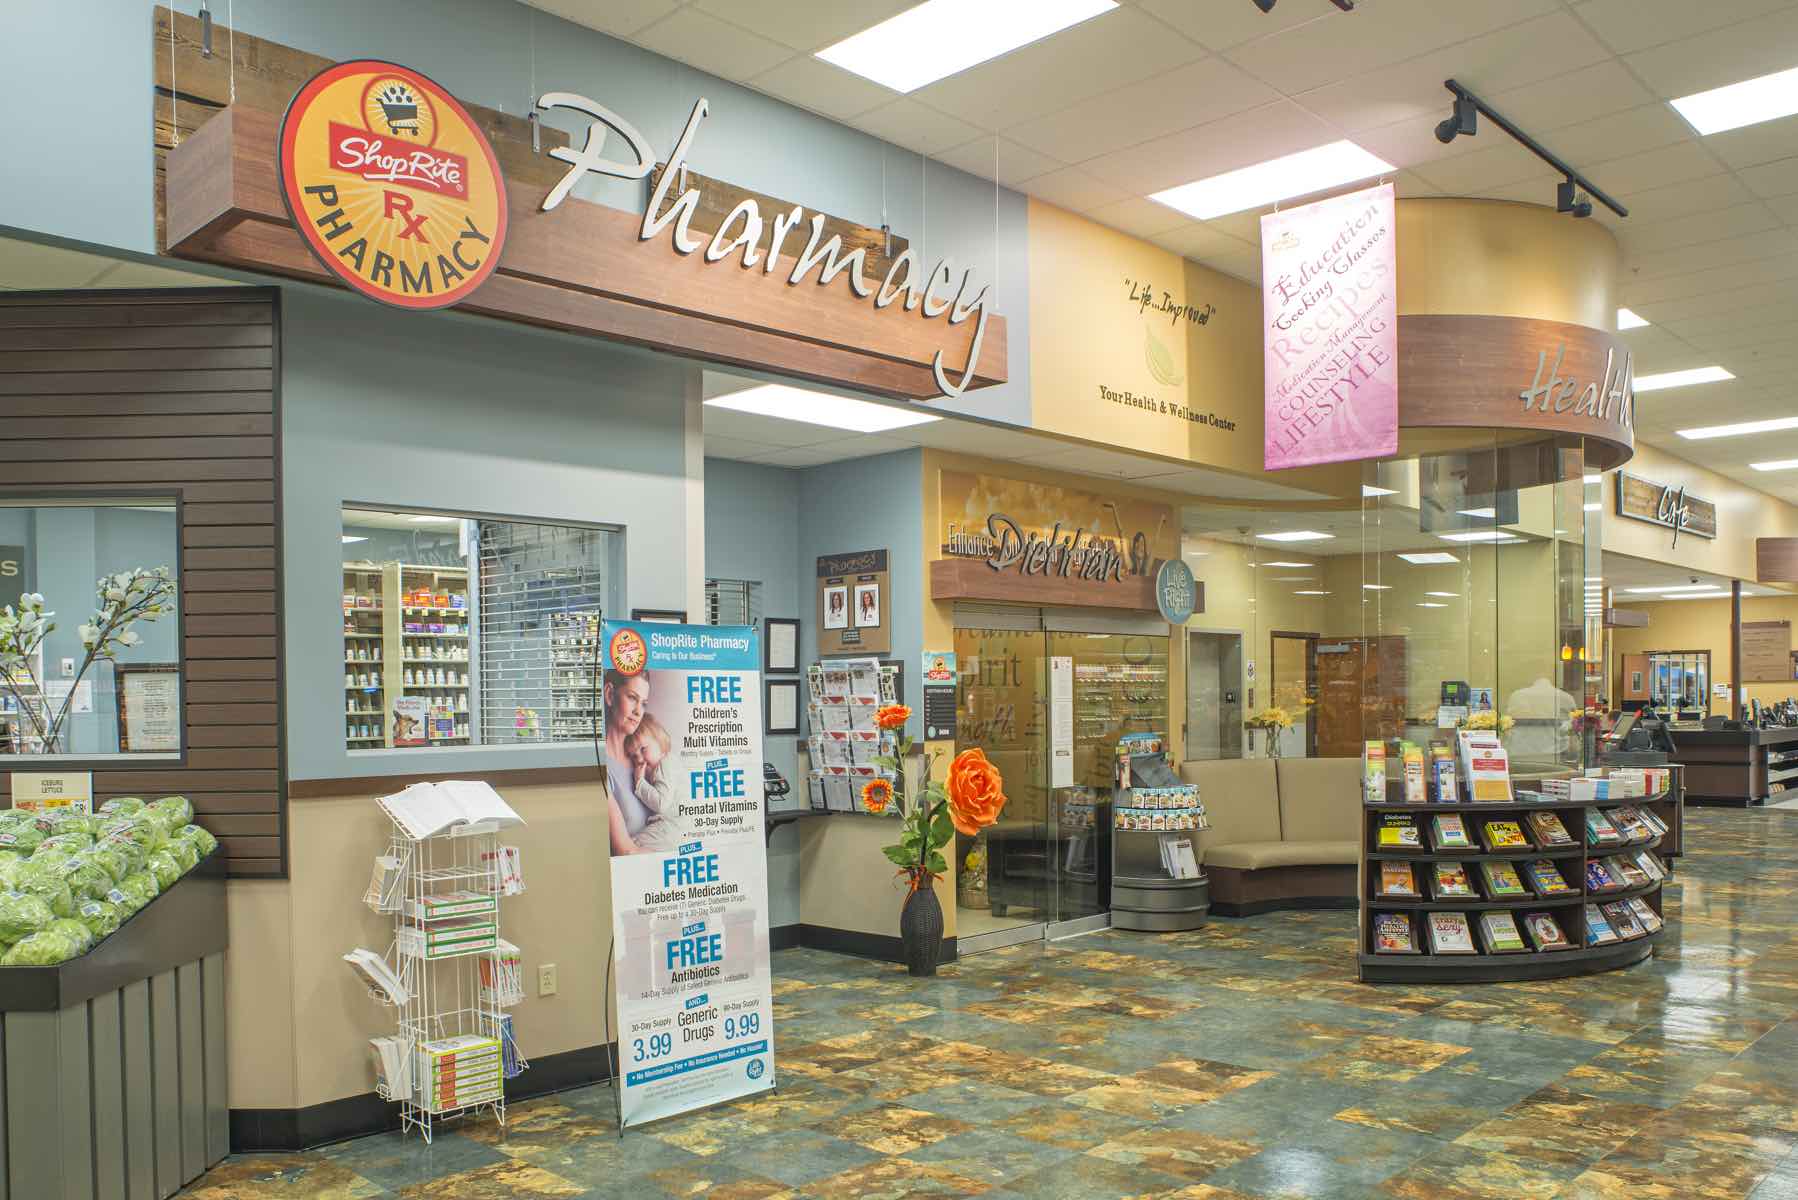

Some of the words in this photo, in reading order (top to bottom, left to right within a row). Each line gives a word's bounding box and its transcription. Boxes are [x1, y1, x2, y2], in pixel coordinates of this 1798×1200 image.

[337, 137, 461, 187] ShopRite
[383, 189, 430, 244] Rx
[304, 184, 490, 294] PHARMACY
[537, 91, 990, 398] Pharmacy
[1272, 204, 1380, 306] Education
[1271, 281, 1334, 330] Cooking
[1272, 257, 1389, 368] Recipes
[1278, 316, 1387, 422] COUNSELING
[1274, 344, 1391, 455] LIFESTYLE
[1520, 342, 1632, 428] Health
[1100, 385, 1123, 403] Your
[1124, 391, 1157, 413] Health
[1159, 400, 1168, 414] &
[1169, 403, 1208, 425] Wellness
[1208, 414, 1237, 432] Center
[651, 632, 697, 650] ShopRite
[700, 634, 750, 652] Pharmacy
[687, 675, 743, 704] FREE
[688, 721, 743, 736] Prescription
[692, 707, 738, 719] Children's
[683, 736, 707, 748] Multi
[709, 735, 748, 747] Vitamins
[690, 769, 745, 800] FREE
[678, 802, 717, 817] Prenatal
[718, 800, 758, 812] Vitamins
[694, 817, 719, 828] 30-Day
[720, 815, 744, 826] Supply
[663, 854, 720, 888] FREE
[644, 889, 686, 905] Diabetes
[688, 883, 738, 899] Medication
[666, 933, 723, 970] FREE
[671, 965, 720, 983] Antibiotics
[653, 1016, 672, 1028] Supply
[677, 1006, 719, 1027] Generic
[724, 1011, 760, 1040] 9.99
[633, 1031, 673, 1063] 3.99
[682, 1024, 715, 1043] Drugs
